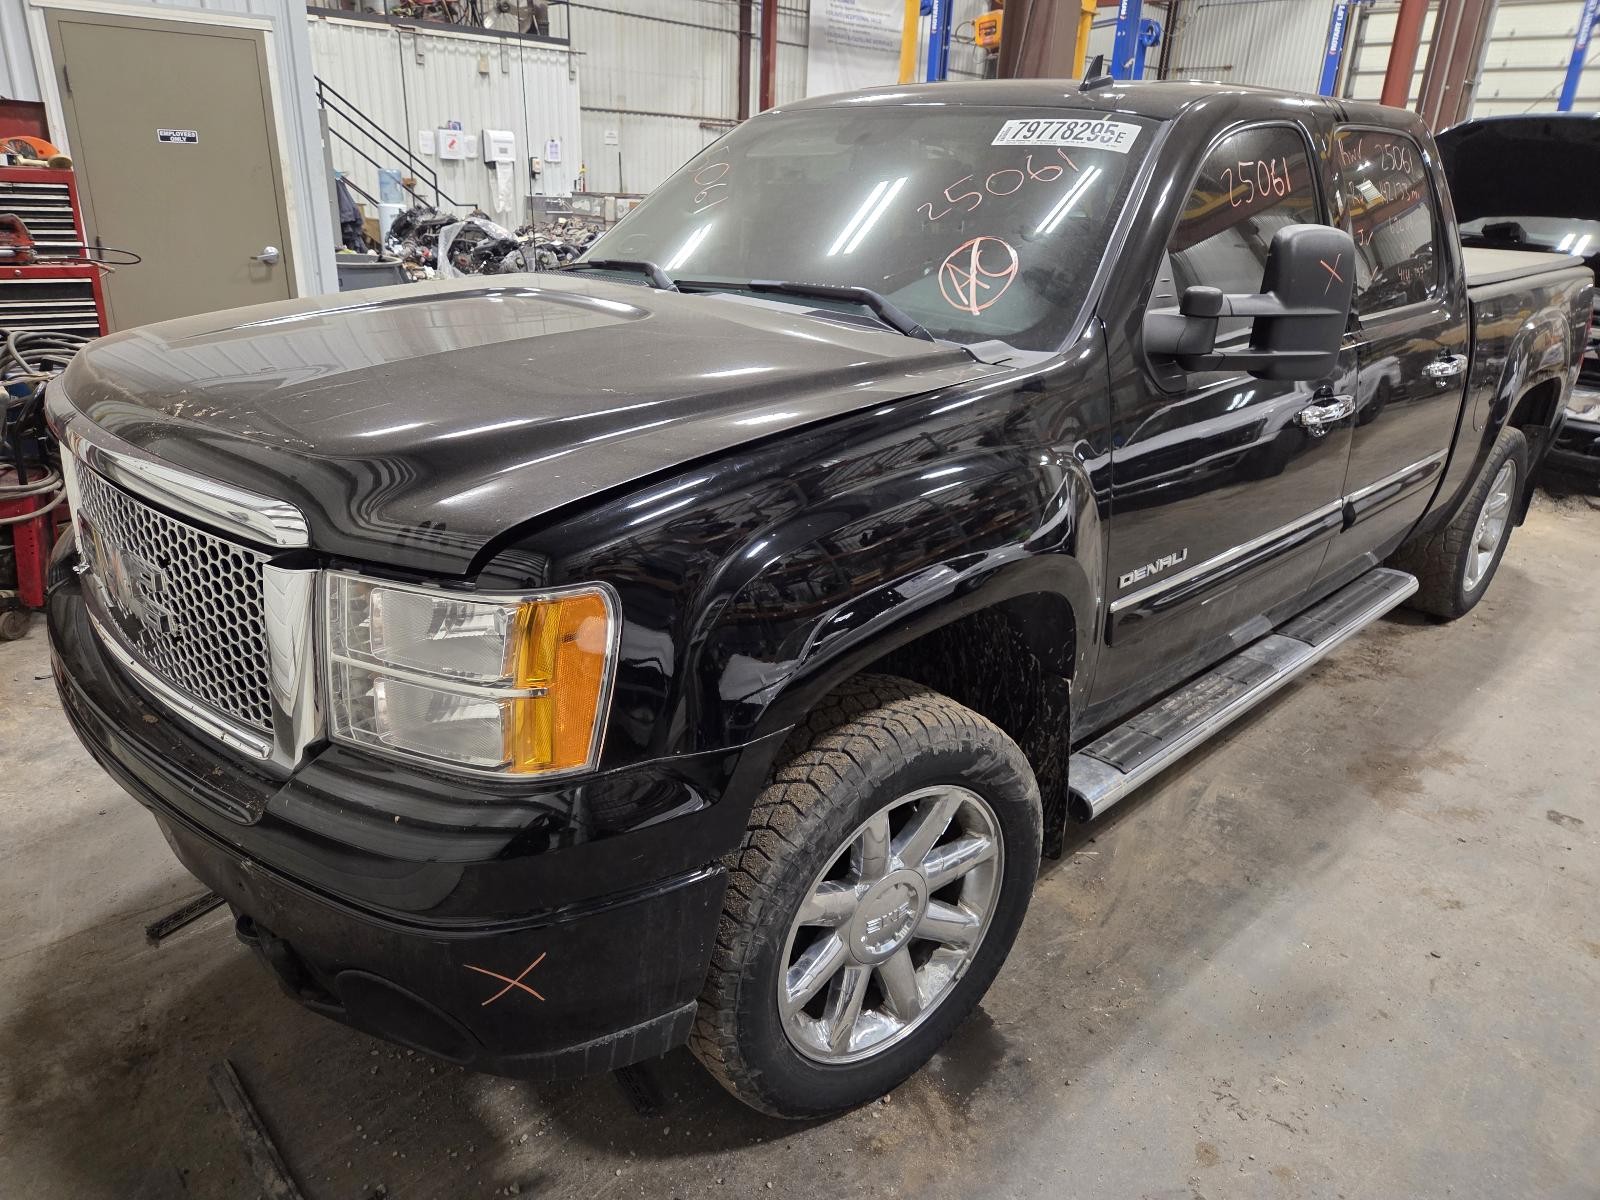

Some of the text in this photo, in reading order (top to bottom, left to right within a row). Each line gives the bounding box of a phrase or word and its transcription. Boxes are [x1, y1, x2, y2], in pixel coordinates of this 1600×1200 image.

[1011, 121, 1119, 144] 79778295
[916, 147, 1080, 221] 25061
[1220, 156, 1292, 208] 25061
[1118, 547, 1188, 590] DENALI
